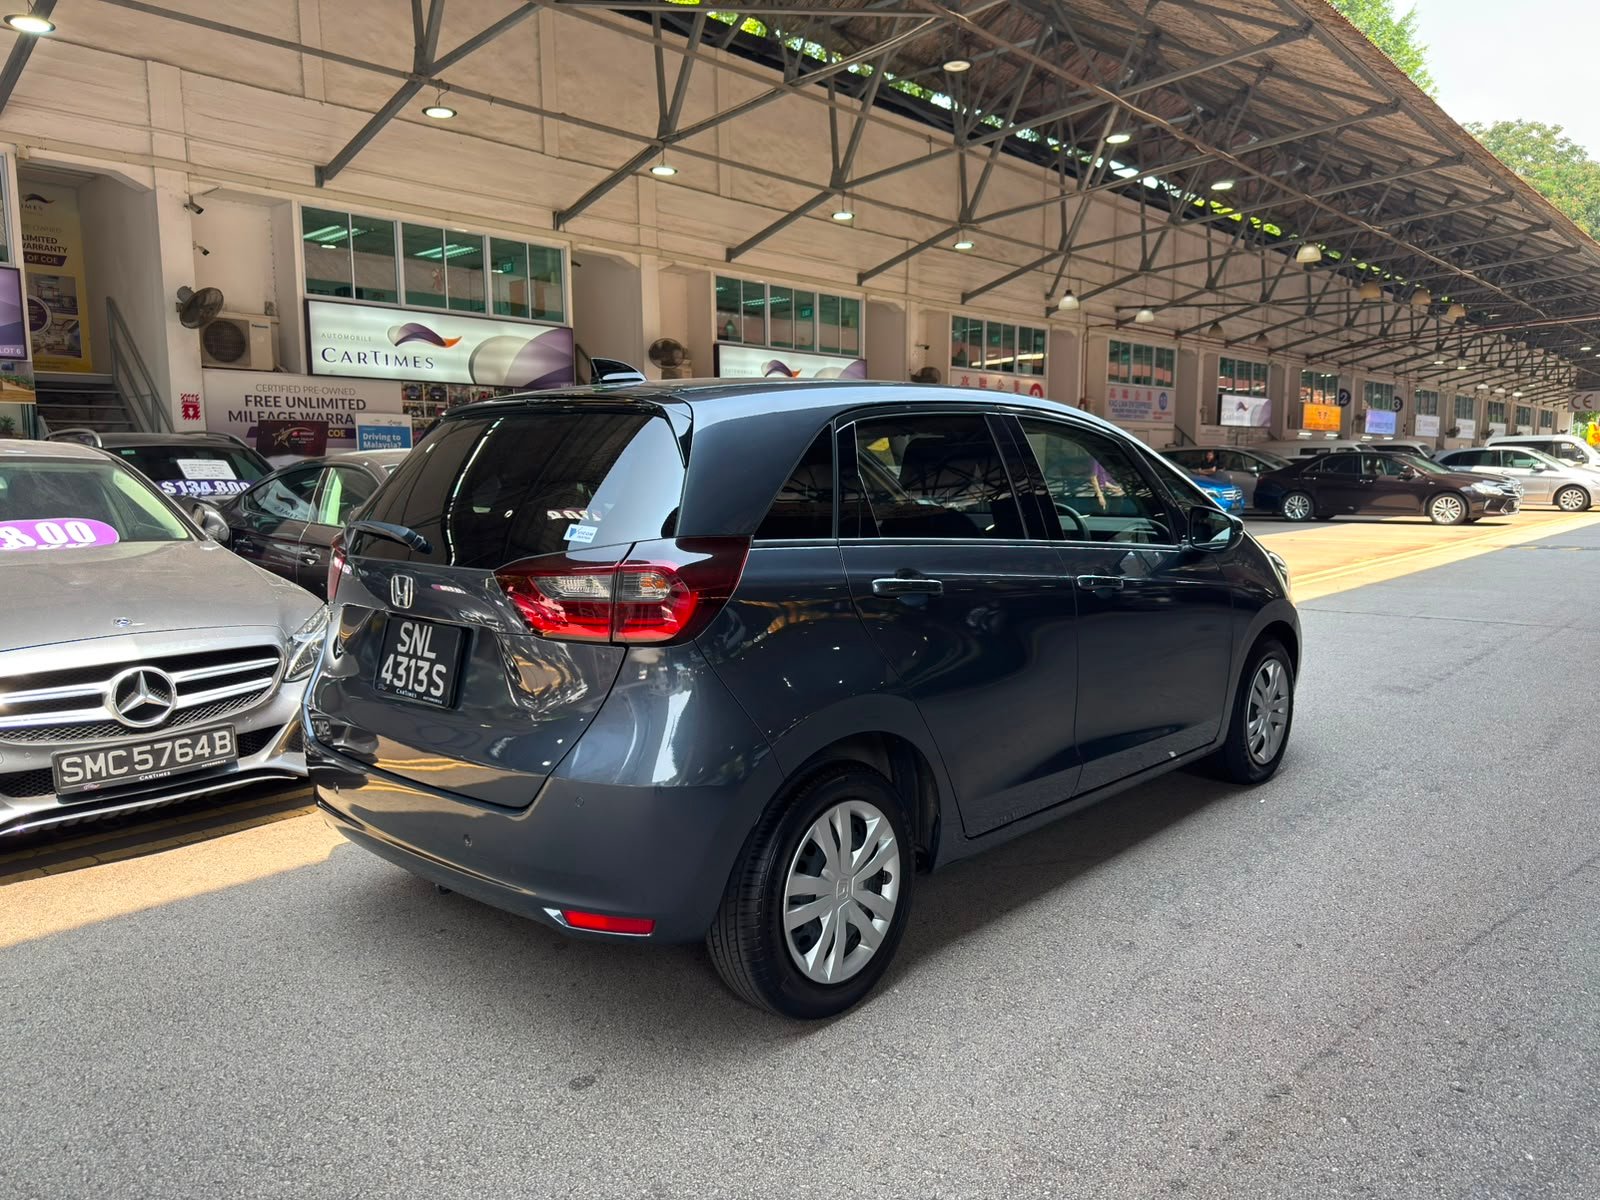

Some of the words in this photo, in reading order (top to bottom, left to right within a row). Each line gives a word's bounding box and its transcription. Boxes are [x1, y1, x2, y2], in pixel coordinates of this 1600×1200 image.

[22, 234, 58, 244] LIMITED
[256, 384, 301, 394] CERTIFIED
[303, 385, 356, 396] PRE-OWNED
[244, 395, 282, 408] FREE
[285, 396, 367, 410] UNLIMITED
[228, 410, 296, 423] MILEAGE
[299, 411, 355, 424] WARRA
[327, 429, 346, 438] COE
[362, 433, 391, 442] Driving
[397, 621, 437, 660] SNL
